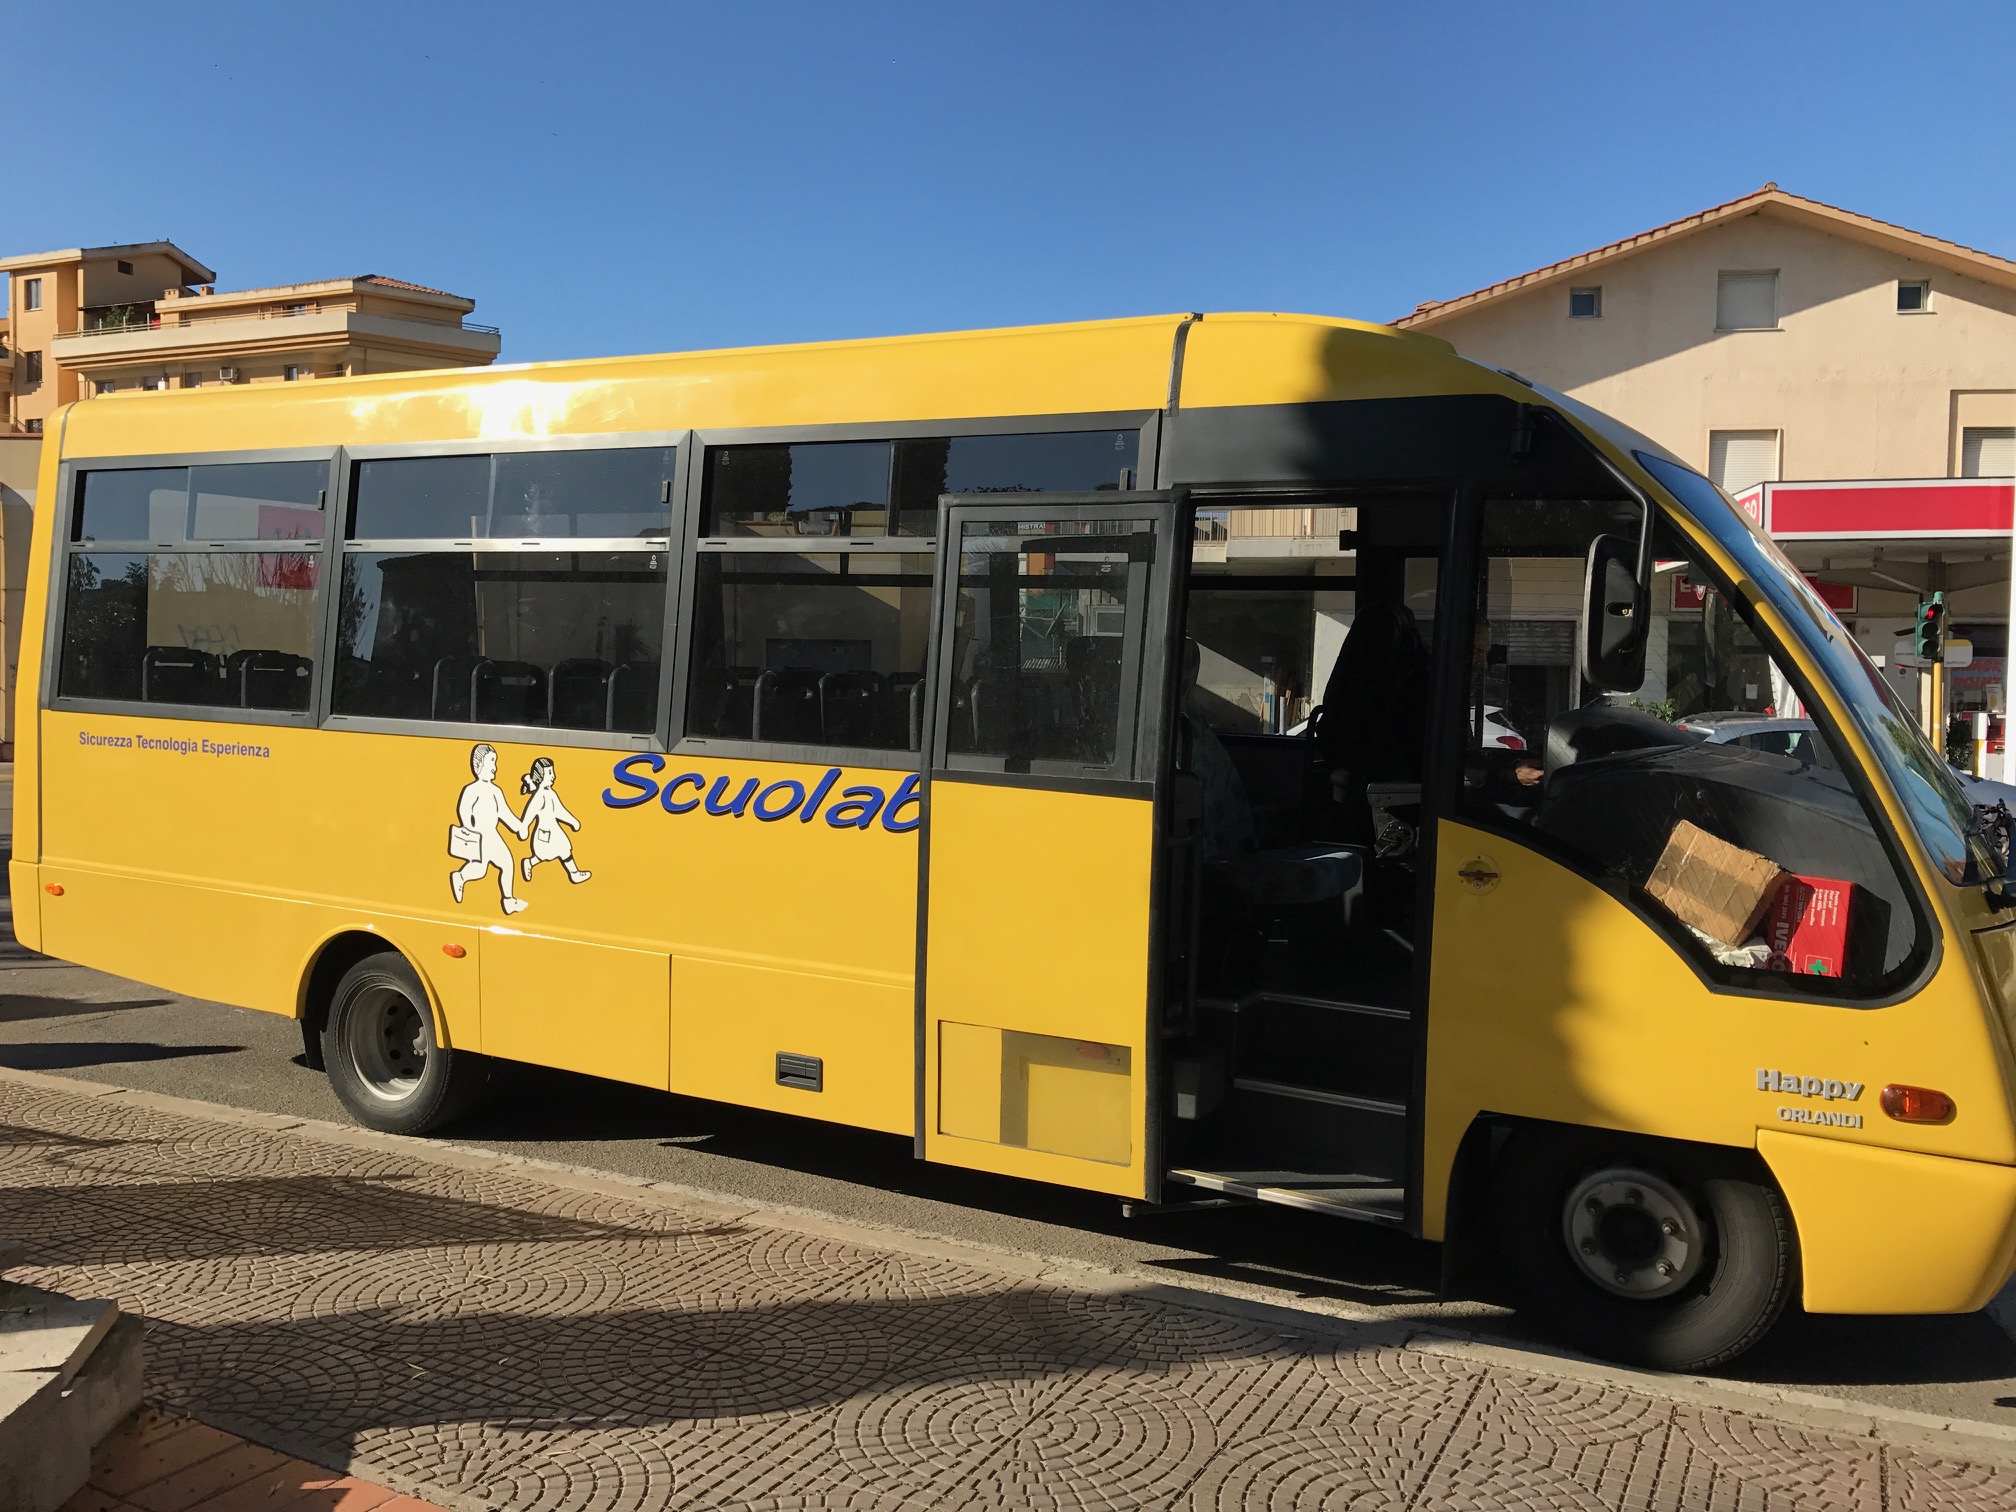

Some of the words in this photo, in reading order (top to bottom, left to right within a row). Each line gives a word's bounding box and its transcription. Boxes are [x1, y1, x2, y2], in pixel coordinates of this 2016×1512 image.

[79, 731, 132, 748] Sicurezza
[136, 734, 198, 755] Tecnologia
[201, 739, 270, 758] Esperienza
[1770, 921, 1790, 972] IVECO
[1757, 1068, 1863, 1101] Happy
[1777, 1106, 1862, 1128] ORLANDI
